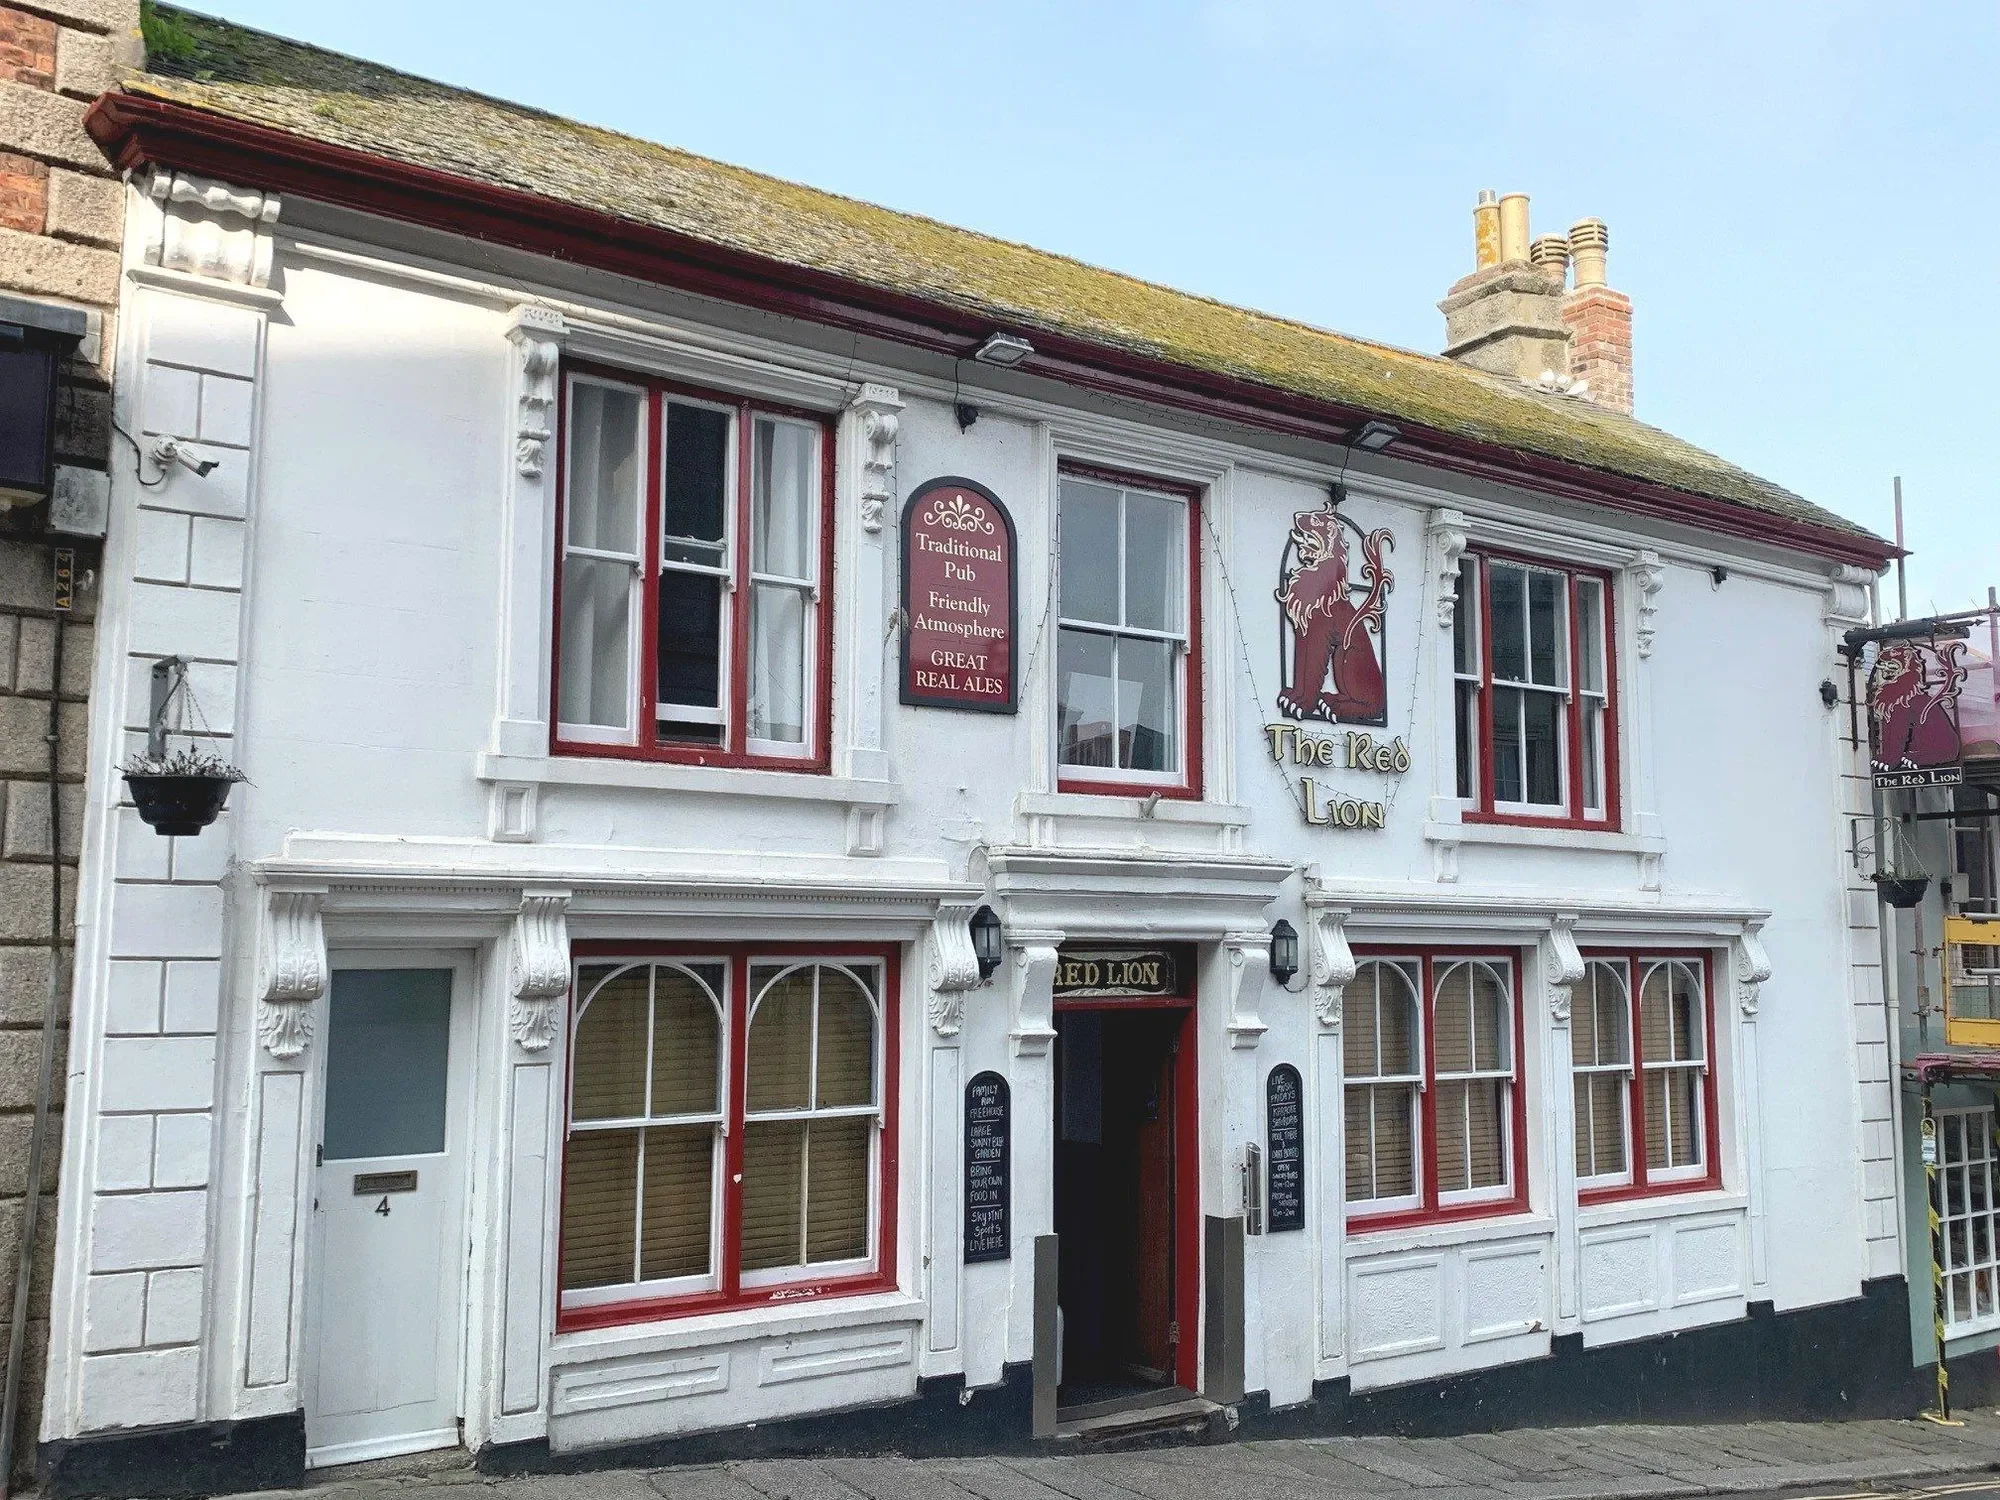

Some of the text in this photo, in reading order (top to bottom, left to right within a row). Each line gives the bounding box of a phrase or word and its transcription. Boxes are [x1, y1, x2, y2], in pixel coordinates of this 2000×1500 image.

[916, 533, 1002, 562] Traditional
[944, 562, 976, 582] Pub
[929, 591, 991, 617] Friendly
[914, 613, 1004, 639] Atmosphere
[931, 650, 988, 671] GREAT
[916, 671, 1003, 695] REAL ALES
[1265, 724, 1411, 773] The Red
[1876, 777, 1897, 786] The
[1902, 775, 1925, 785] Red
[1107, 962, 1160, 985] LION
[1272, 1075, 1285, 1085] LIVE
[972, 1085, 998, 1097] FAMILY
[1271, 1090, 1296, 1103] FRIDAYS
[981, 1097, 994, 1105] RUN
[970, 1106, 1004, 1118] FREEHOUSE
[970, 1125, 991, 1137] LARGE
[970, 1138, 991, 1148] SUNNY
[975, 1148, 1001, 1159] GARDEN
[970, 1166, 992, 1177] BRING
[970, 1176, 1002, 1189] YOUR OWN
[970, 1190, 998, 1203] FOOD IN
[375, 1195, 391, 1217] 4
[970, 1234, 1004, 1251] LIVE HERE
